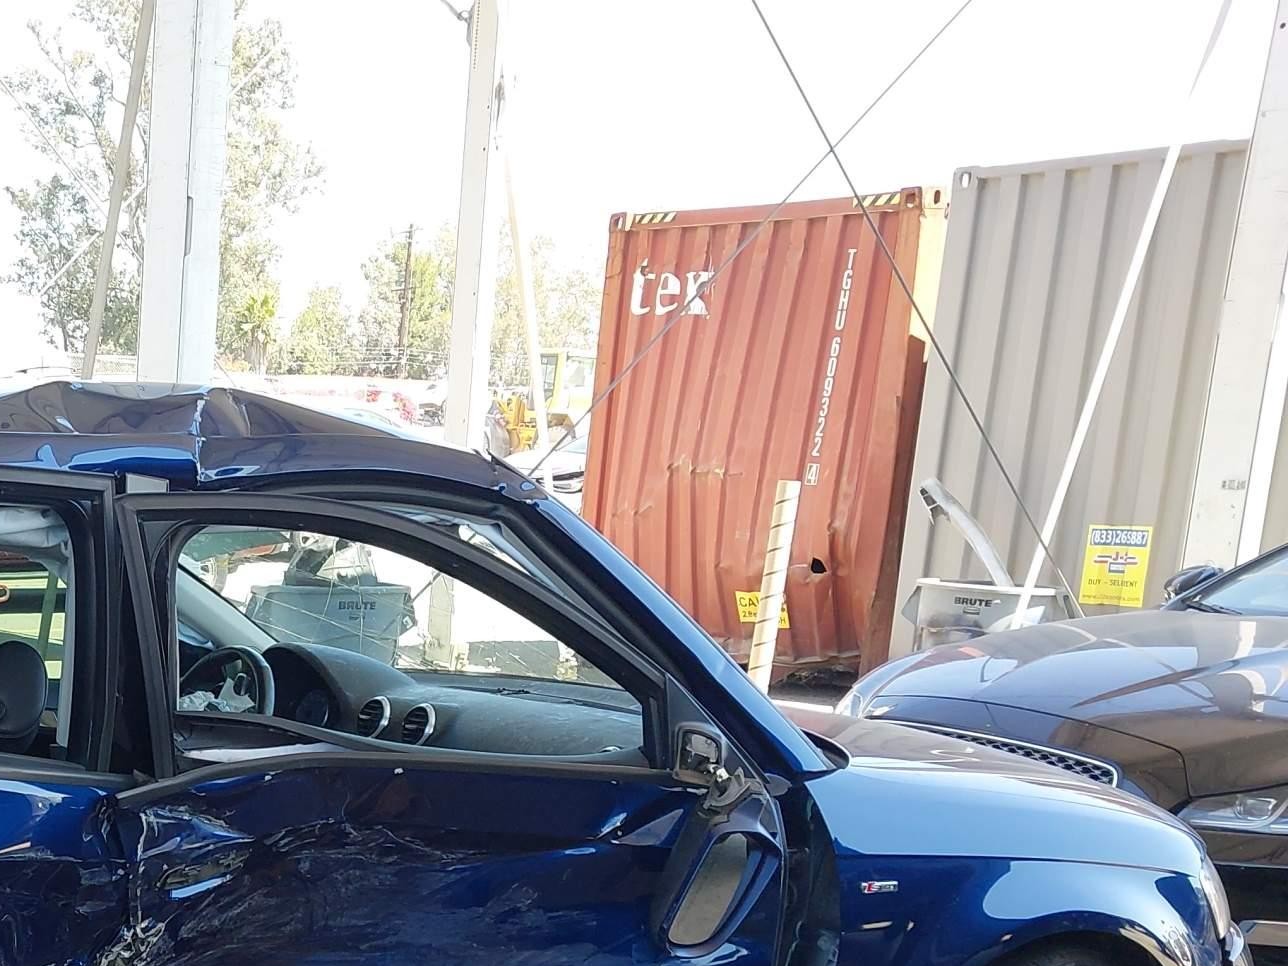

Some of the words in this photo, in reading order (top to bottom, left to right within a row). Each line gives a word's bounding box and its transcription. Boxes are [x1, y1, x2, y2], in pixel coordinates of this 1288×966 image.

[834, 248, 858, 331] TGHU
[811, 336, 842, 457] 609322
[805, 463, 820, 485] 4
[338, 600, 377, 610] BRUTE
[954, 596, 992, 607] BRUTE
